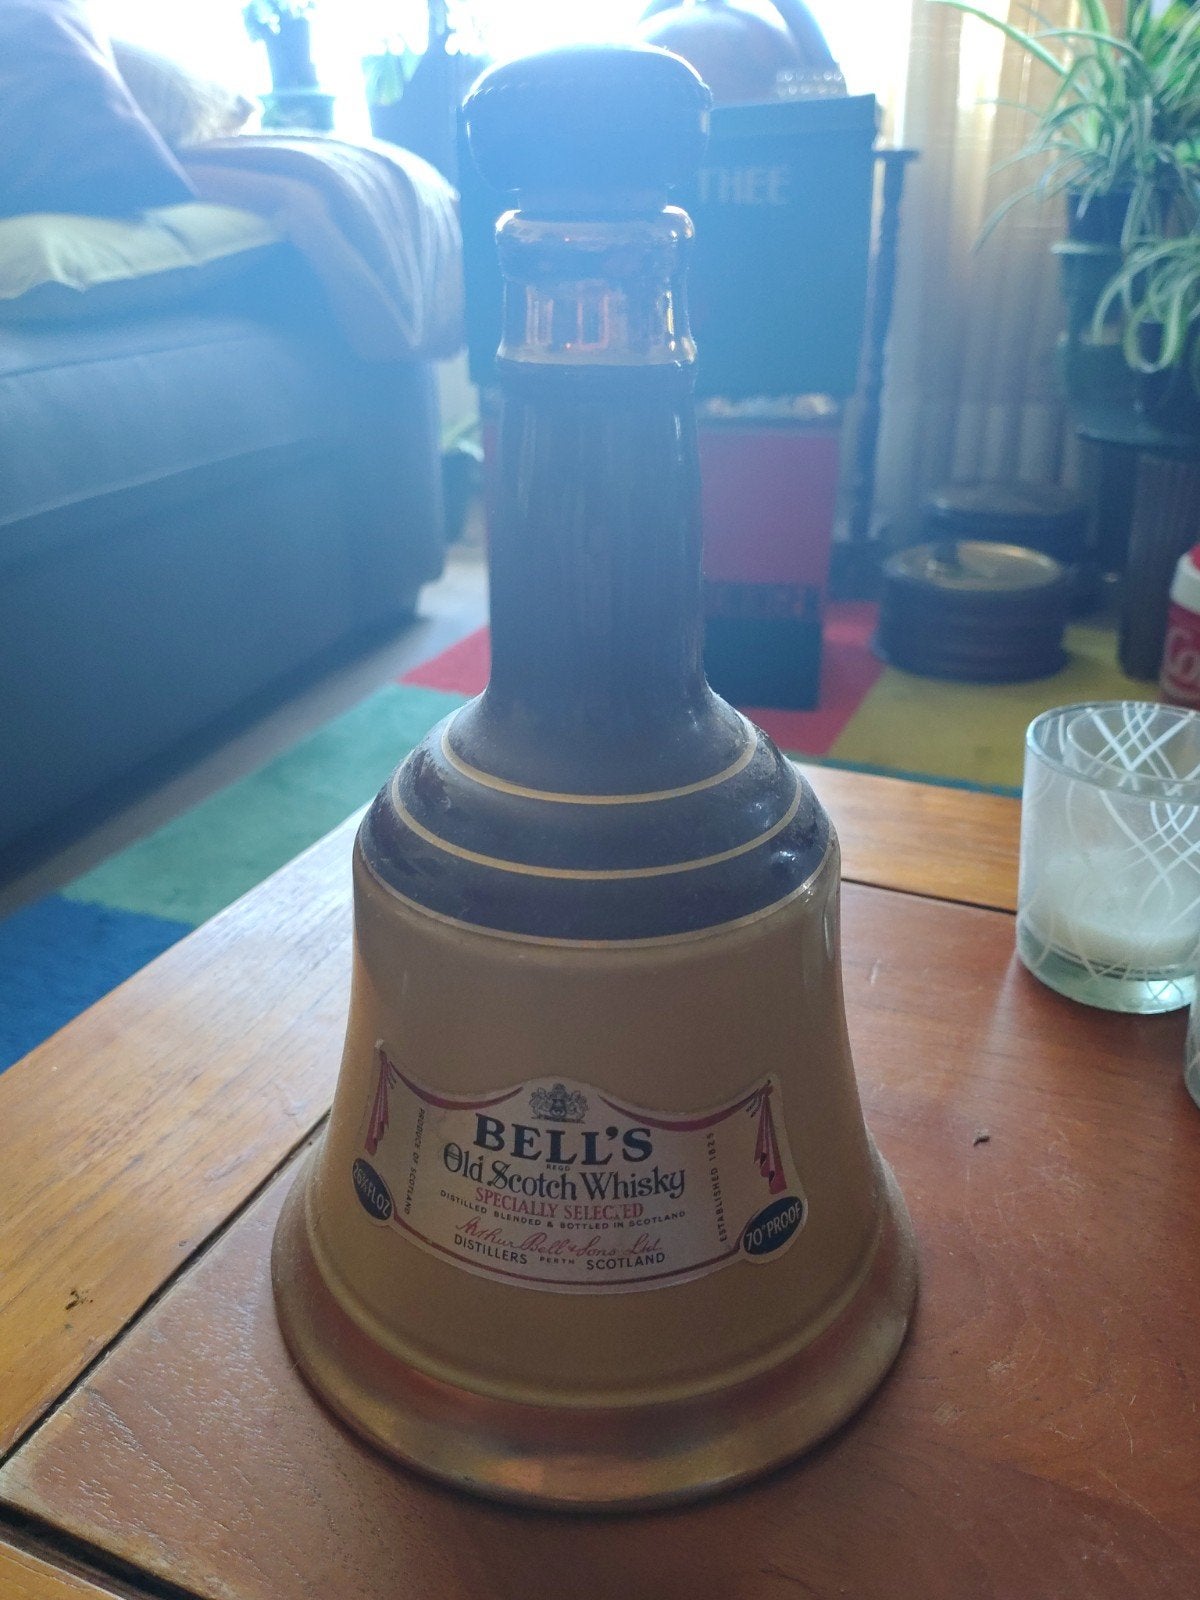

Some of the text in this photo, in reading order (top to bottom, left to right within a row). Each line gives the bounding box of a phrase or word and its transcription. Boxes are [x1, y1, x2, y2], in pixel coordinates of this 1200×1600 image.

[404, 1107, 426, 1216] PRODUCE OF SCOTLAND
[473, 1113, 653, 1166] BELL'S
[443, 1142, 686, 1201] Old Scotch Whisky
[706, 1132, 728, 1243] ESTABLISHED 1825
[440, 1189, 487, 1214] DISTILLED
[493, 1210, 542, 1227] BLENDED
[560, 1222, 609, 1230] BOTTLED
[628, 1210, 686, 1227] SCOTLAND
[475, 1186, 558, 1219] SPECIALLY
[454, 1233, 666, 1271] DISTILLERS PERTH SCOTLAND
